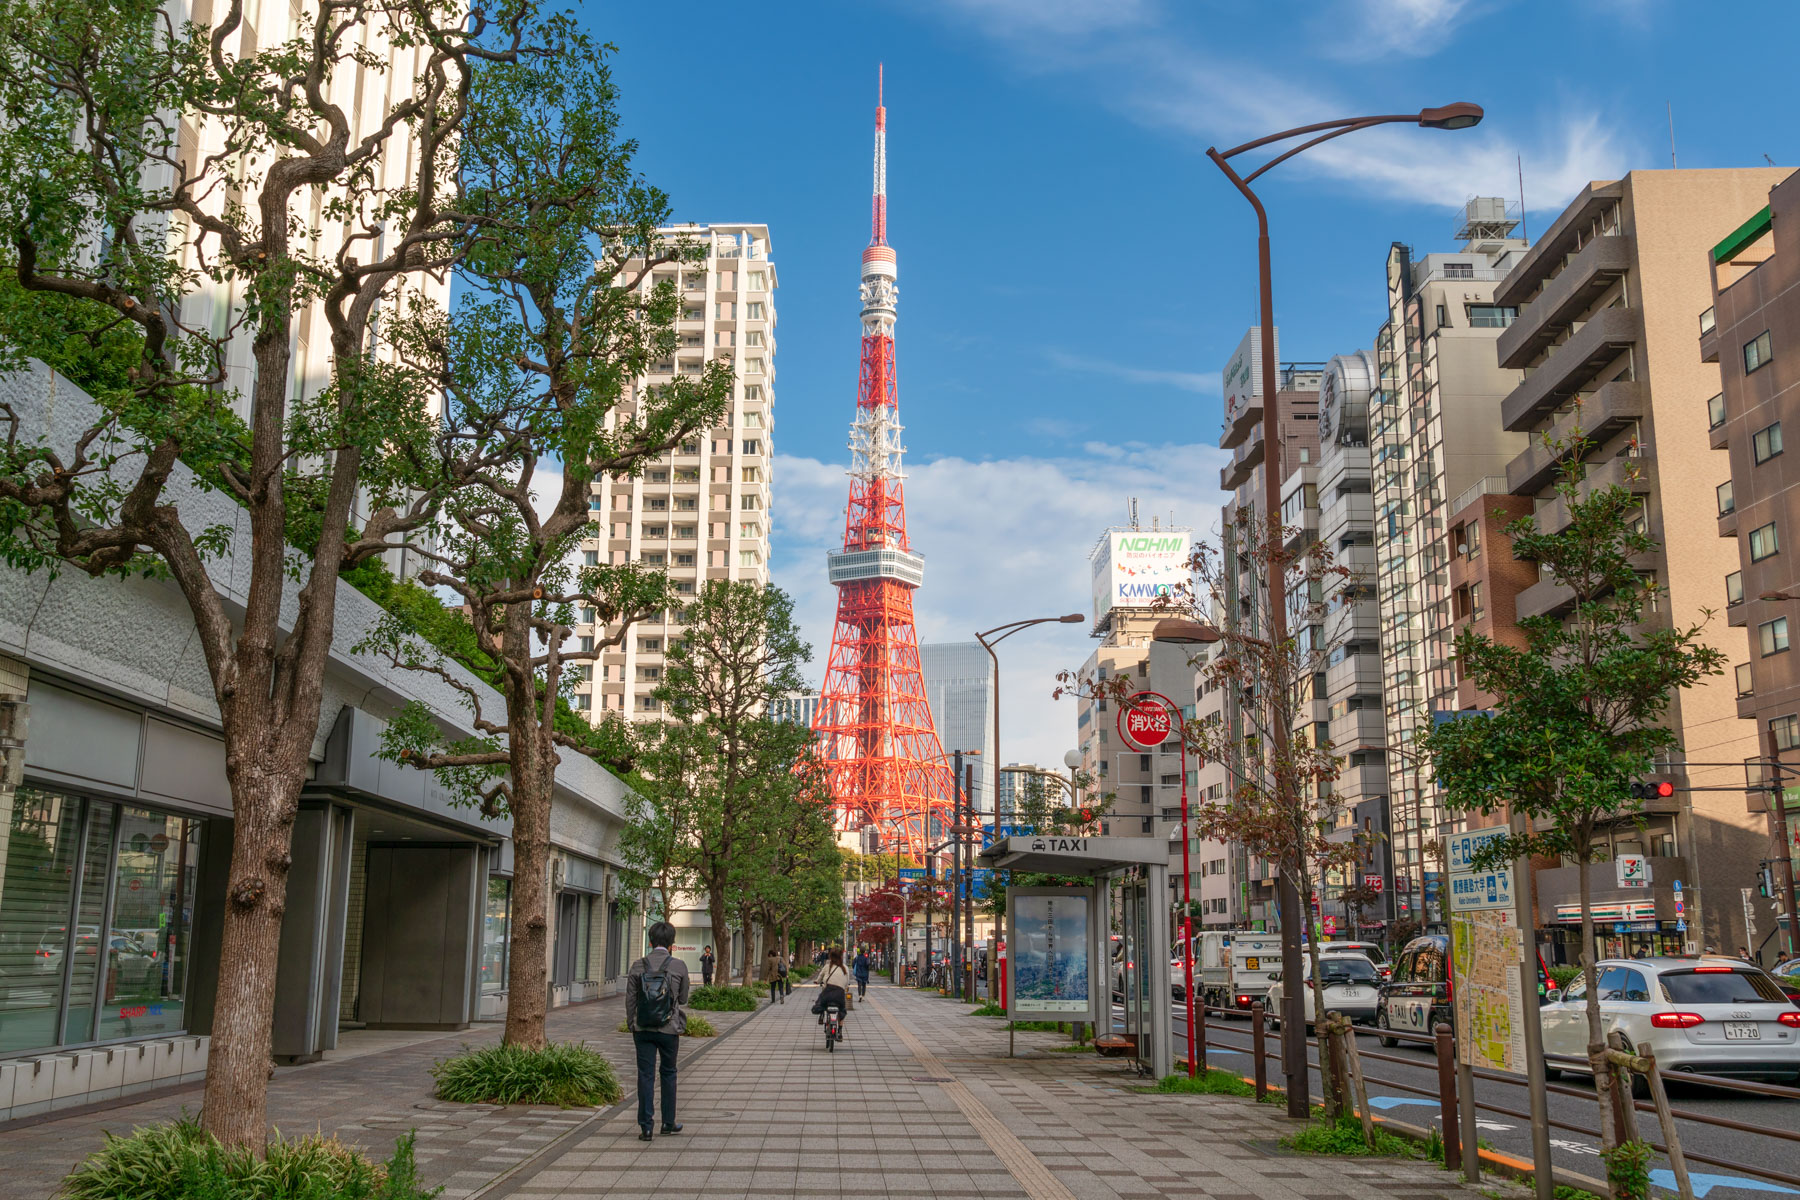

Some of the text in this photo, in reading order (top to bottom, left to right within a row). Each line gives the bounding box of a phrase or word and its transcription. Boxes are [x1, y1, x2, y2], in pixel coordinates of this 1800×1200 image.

[1119, 538, 1183, 552] NOHMI
[1131, 714, 1168, 732] 消火栓
[1049, 839, 1088, 851] TAXI
[120, 1006, 147, 1019] SHARP
[1734, 1029, 1758, 1038] 17-20
